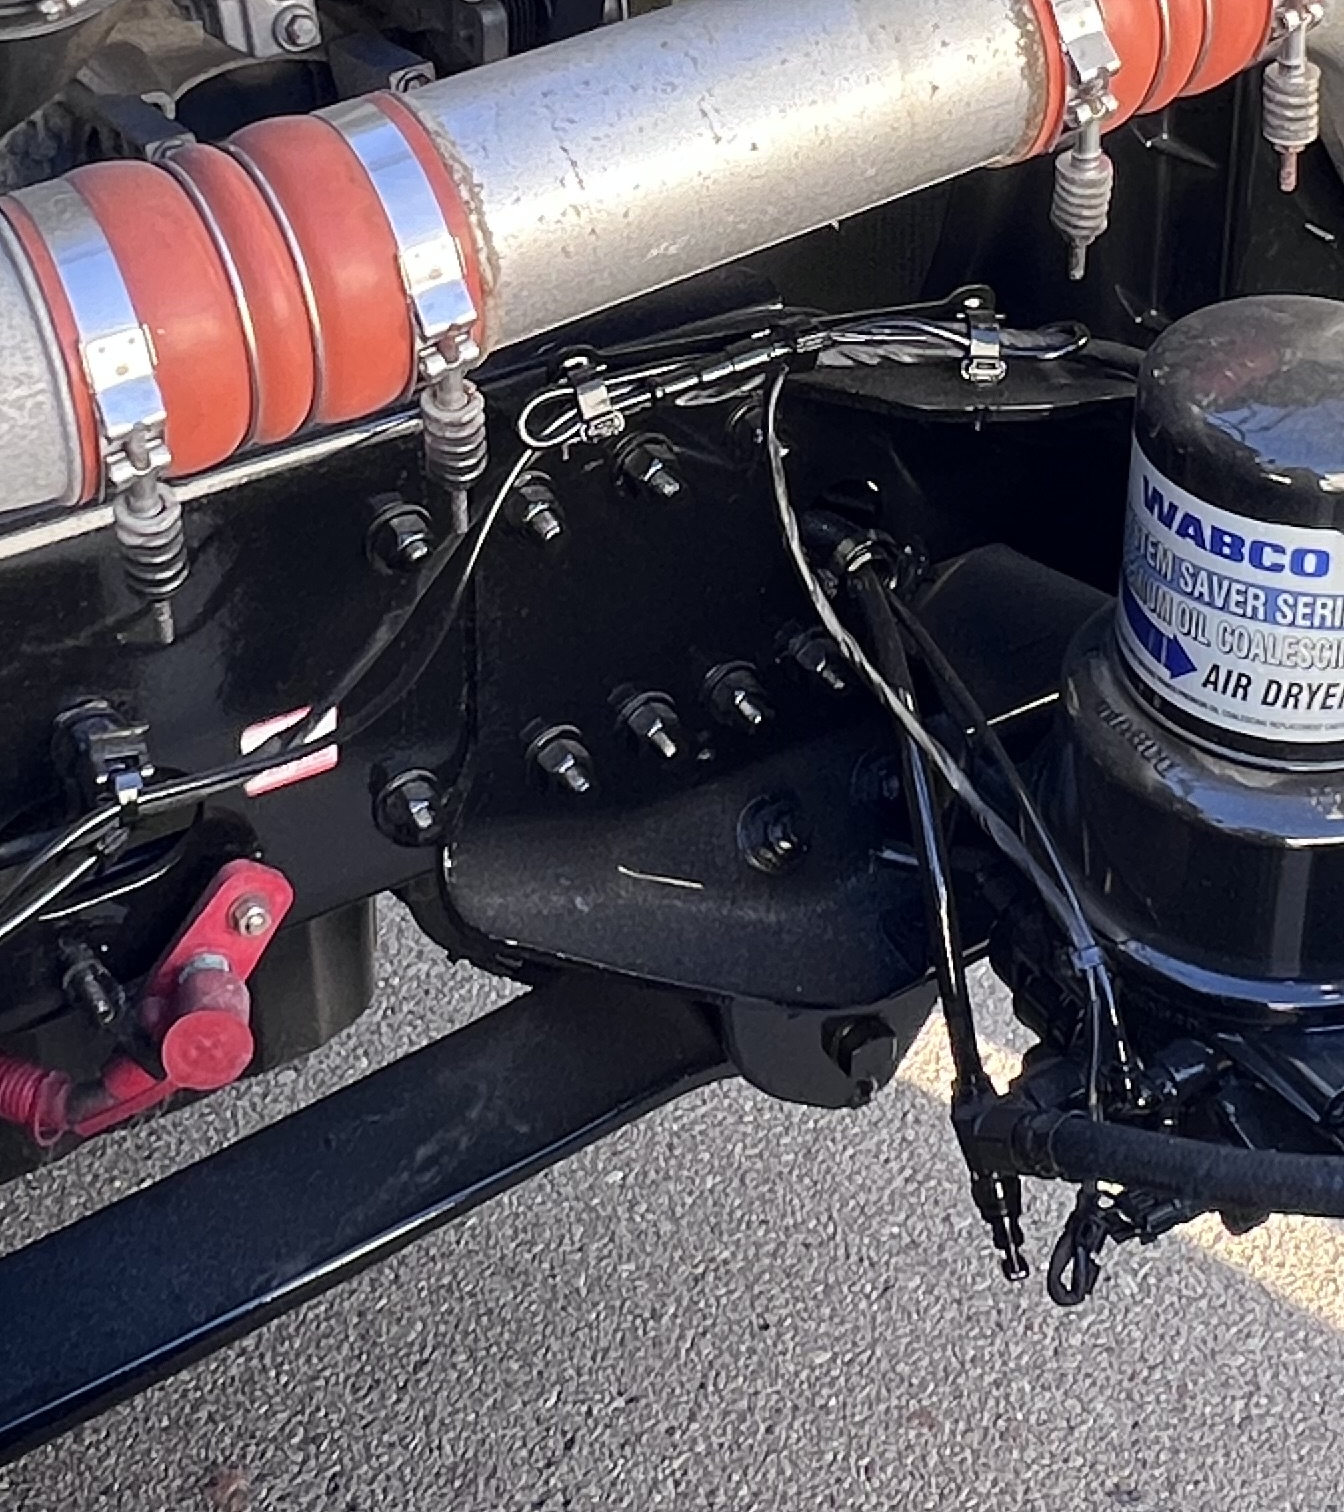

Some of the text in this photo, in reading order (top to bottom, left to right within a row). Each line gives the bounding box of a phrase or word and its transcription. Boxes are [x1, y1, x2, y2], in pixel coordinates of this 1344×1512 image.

[1143, 474, 1330, 577] WABCO
[1179, 561, 1267, 621] SAVER
[1177, 600, 1211, 647] OIL
[1201, 663, 1252, 701] AIR
